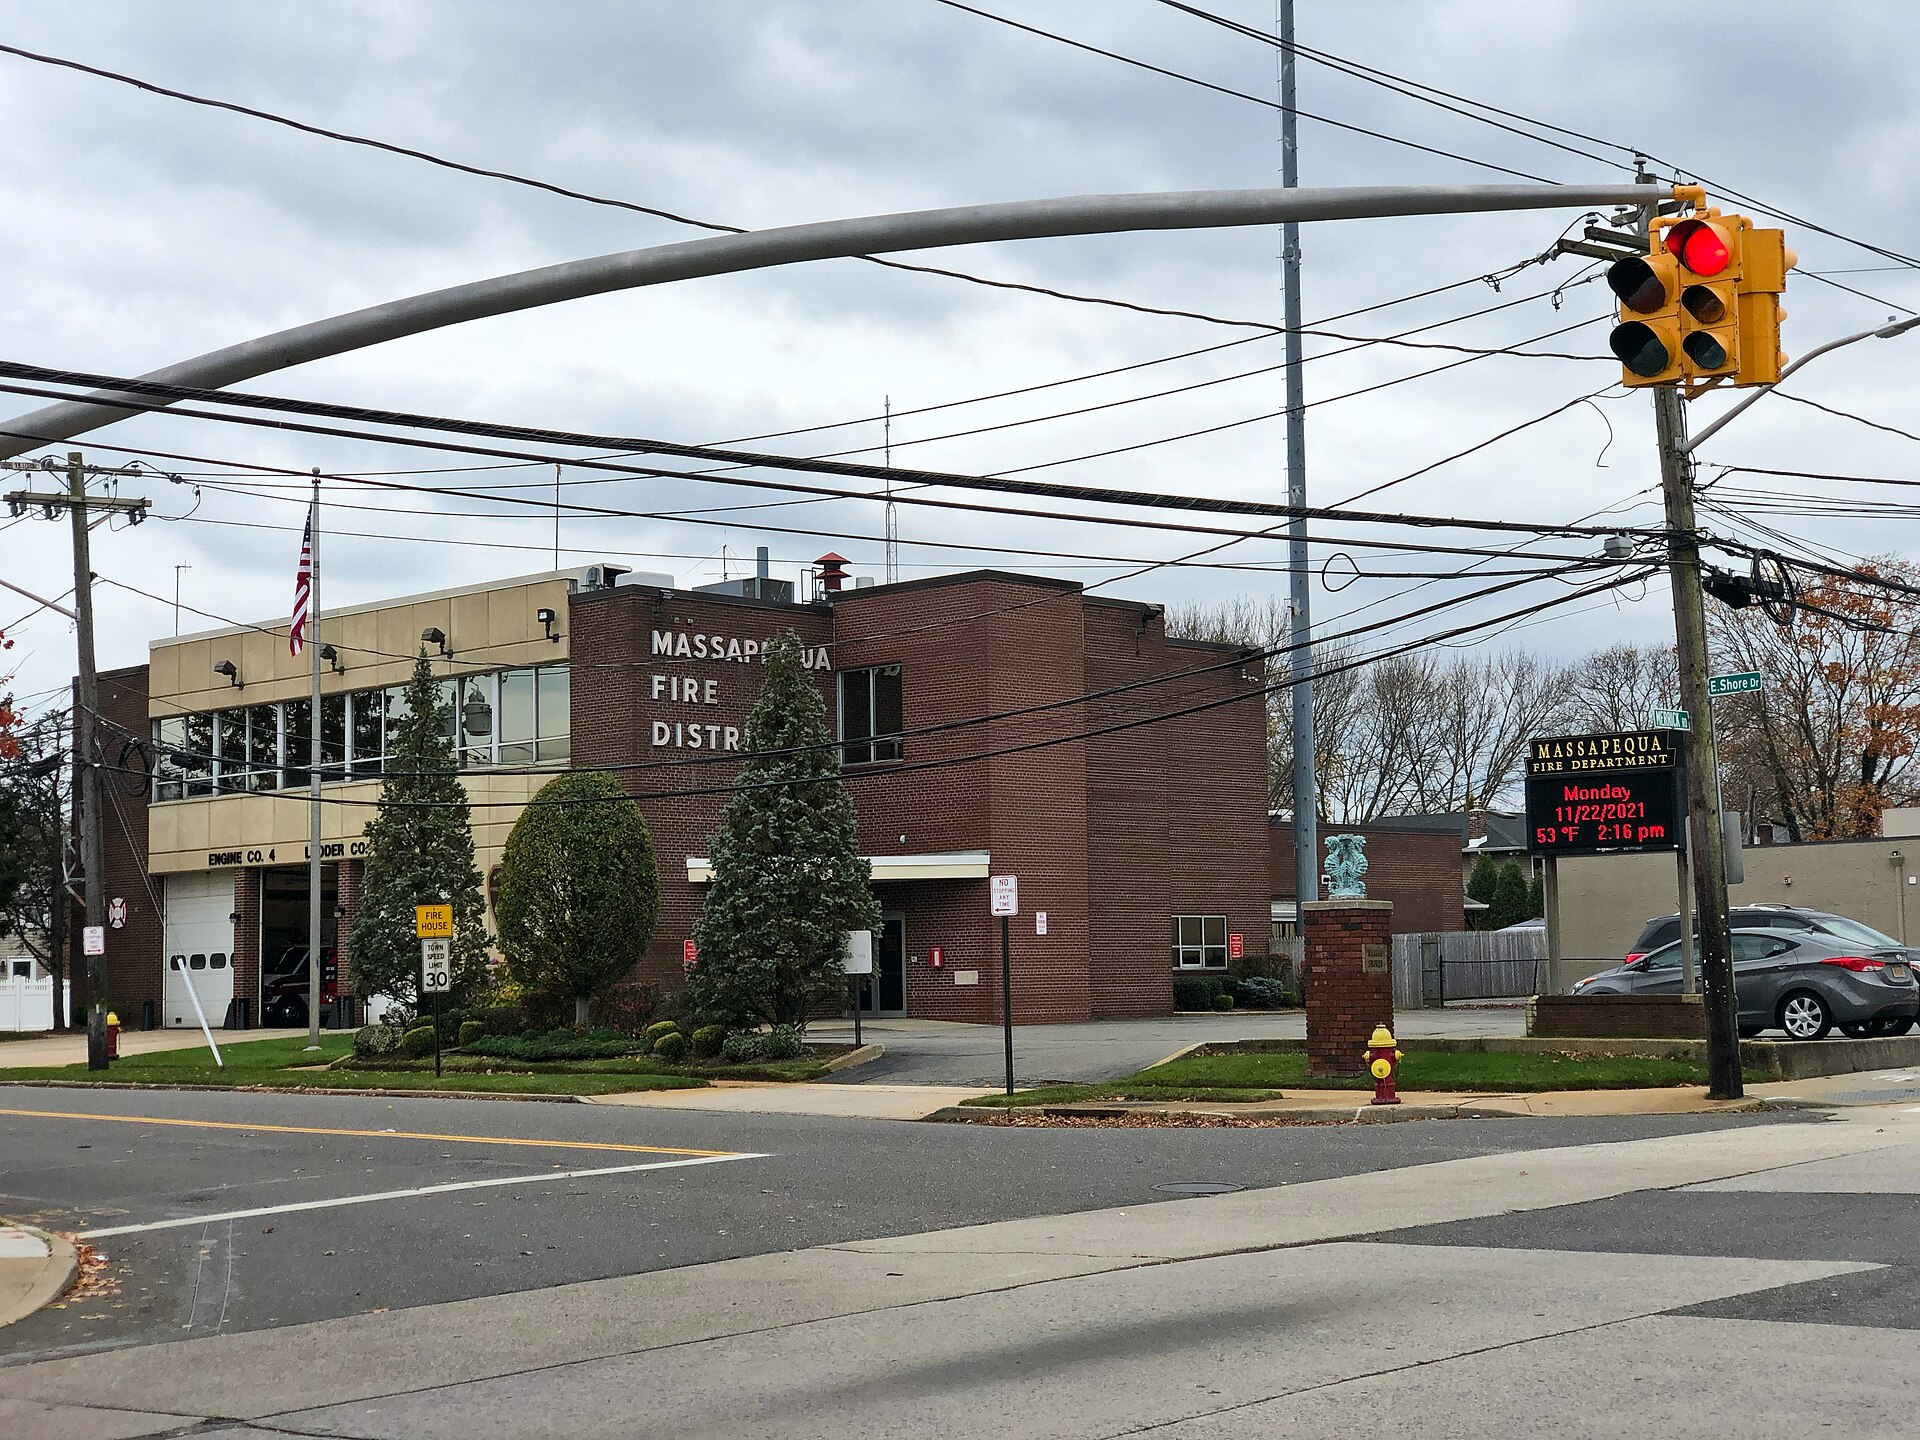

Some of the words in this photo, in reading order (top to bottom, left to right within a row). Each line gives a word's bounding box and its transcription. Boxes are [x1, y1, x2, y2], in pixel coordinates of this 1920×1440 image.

[651, 630, 831, 671] MASSAPUA
[651, 675, 718, 704] FIRE
[1750, 677, 1759, 687] Dr
[651, 721, 752, 750] DISTR
[1537, 735, 1662, 759] MASSAPEQUA
[1533, 761, 1563, 773] FIRE
[1571, 754, 1668, 770] DEPARTMENT
[1563, 783, 1631, 801] Monday
[1555, 802, 1645, 823] 11/22/2021
[1536, 827, 1556, 843] 53
[1561, 826, 1580, 842] °F
[1598, 823, 1633, 840] 2:16
[1638, 825, 1665, 842] pm
[208, 851, 243, 866] ENGINE
[246, 849, 264, 863] CO.
[268, 848, 276, 862] 4
[426, 912, 442, 920] FIRE
[421, 922, 447, 931] HOUSE
[425, 972, 448, 987] 30
